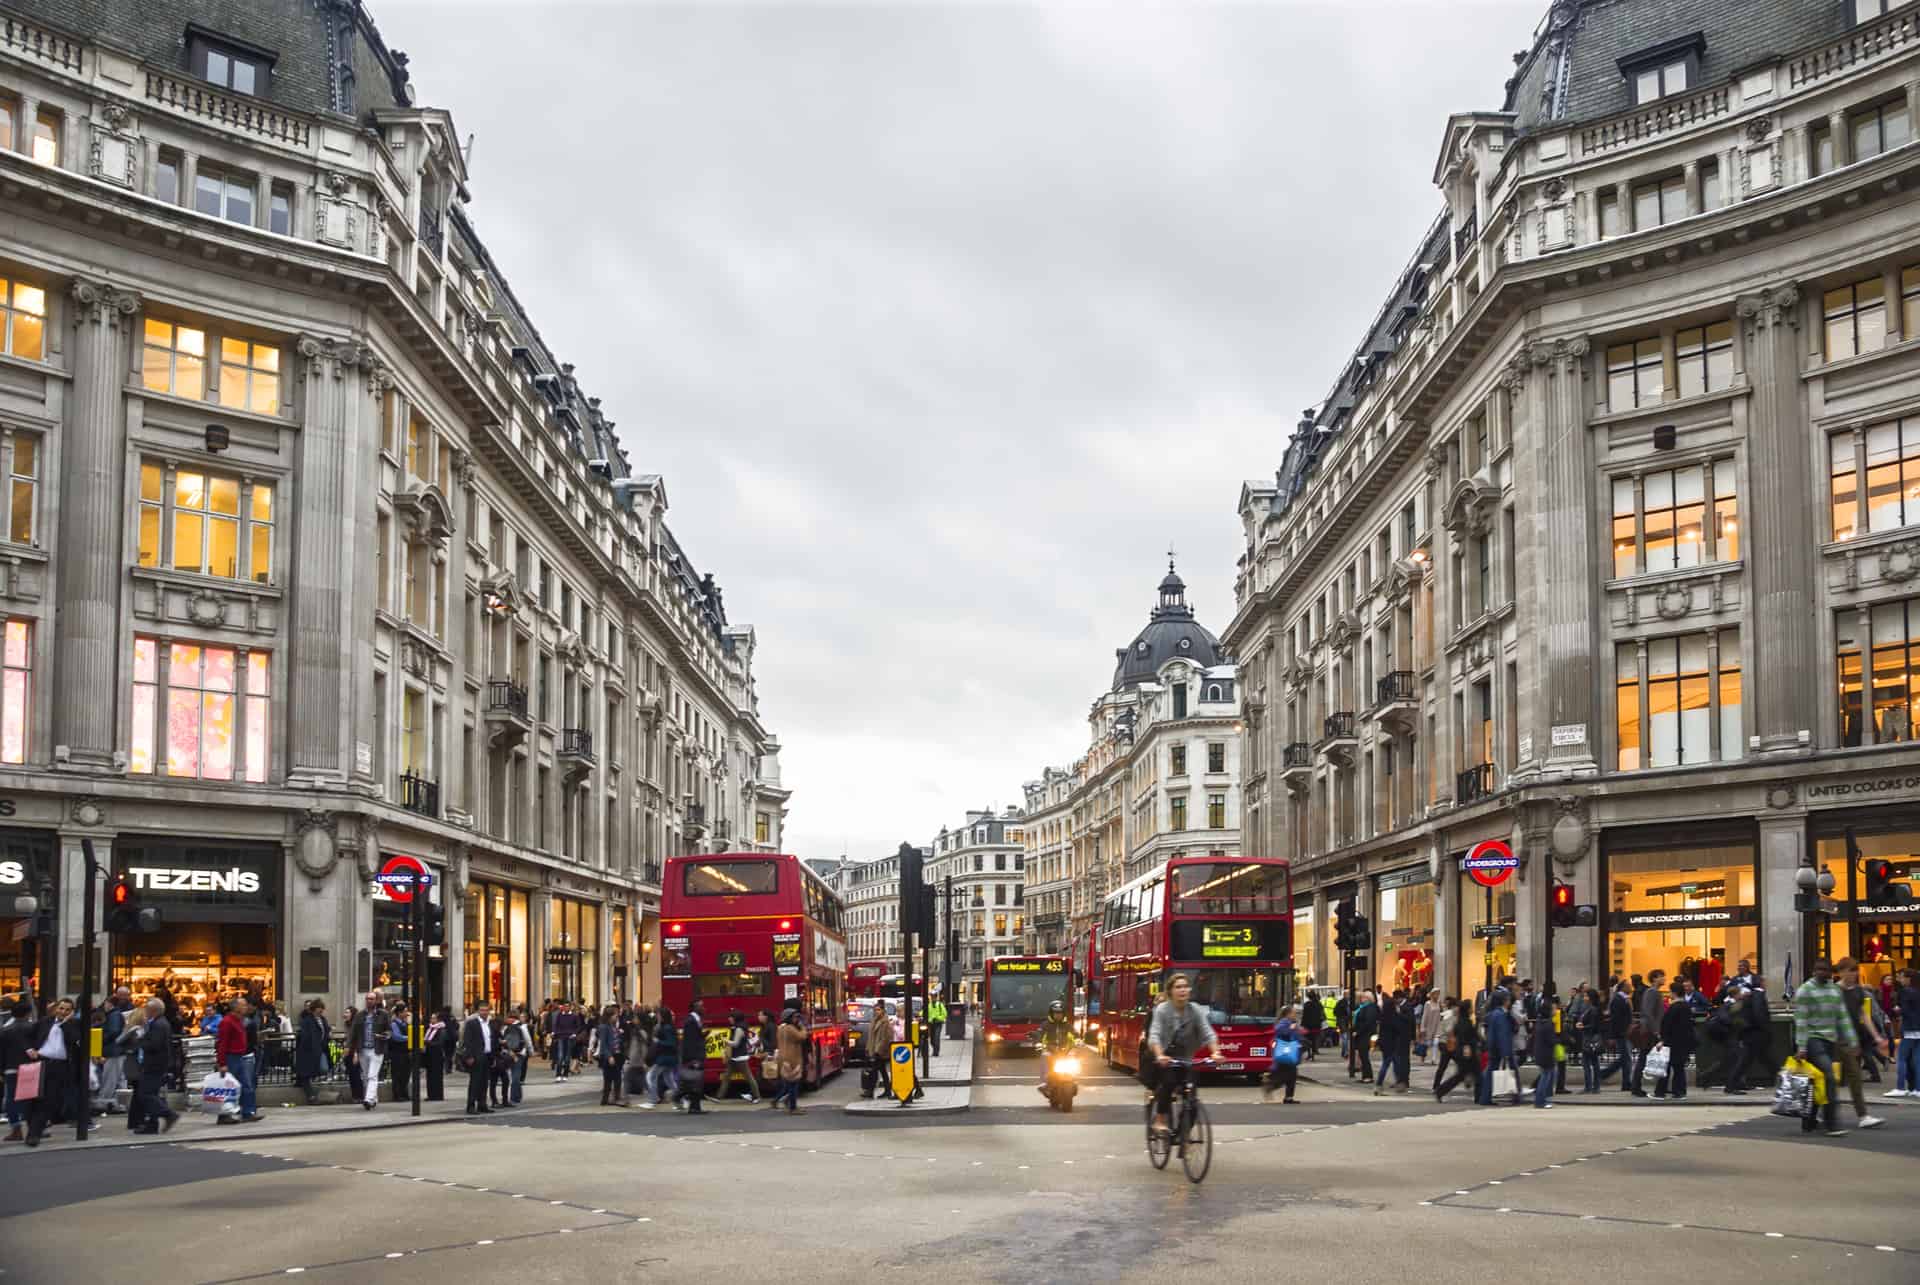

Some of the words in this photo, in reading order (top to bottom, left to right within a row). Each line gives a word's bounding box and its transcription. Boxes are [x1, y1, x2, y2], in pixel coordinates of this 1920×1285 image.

[1808, 784, 1850, 797] UNITED
[1853, 779, 1900, 793] COLORS
[1466, 859, 1517, 868] UNDERGROUND
[128, 867, 260, 892] TEZENIS
[1629, 916, 1655, 924] UNITED
[1655, 914, 1682, 923] COLORS
[1694, 912, 1731, 921] BENETTON
[1242, 928, 1252, 942] 3
[722, 952, 740, 966] 23
[1045, 960, 1063, 972] 453
